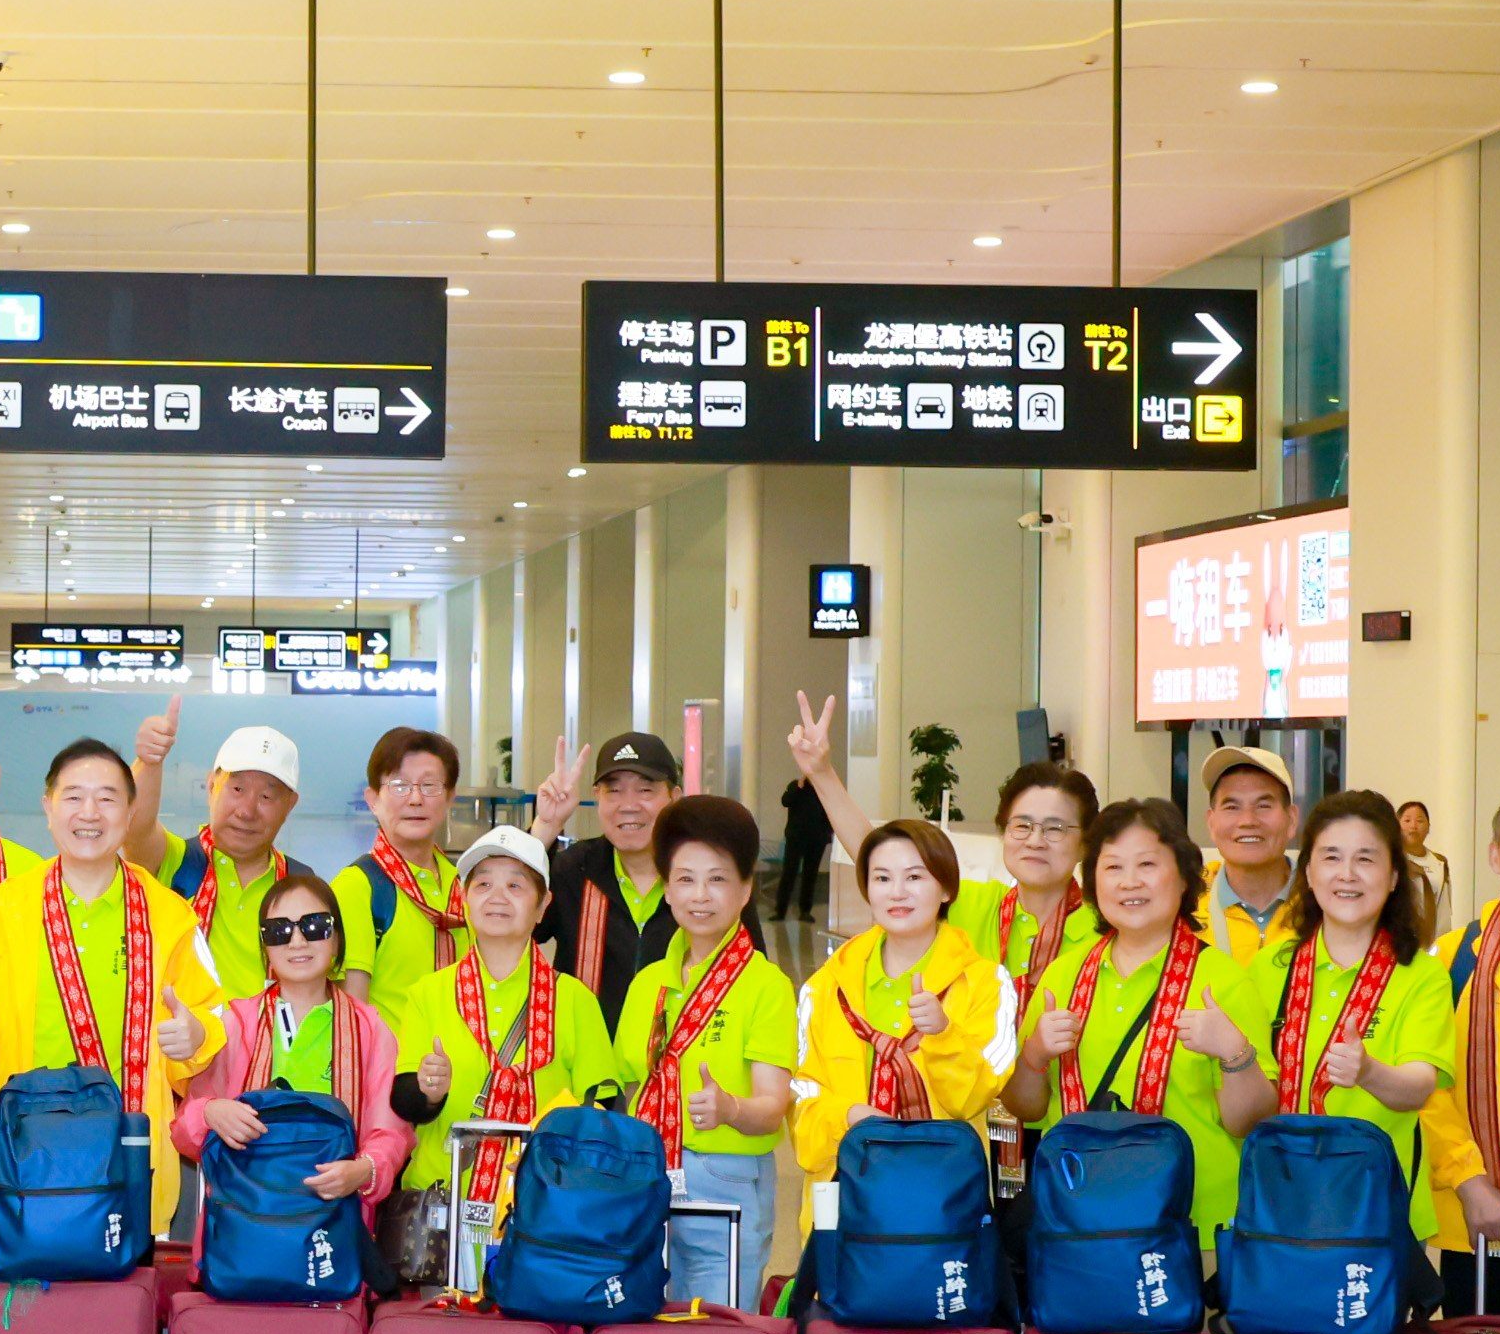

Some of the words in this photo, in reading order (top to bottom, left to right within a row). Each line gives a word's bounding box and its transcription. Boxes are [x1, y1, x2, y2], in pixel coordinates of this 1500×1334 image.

[619, 320, 694, 347] 停车场
[864, 322, 1013, 350] 龙洞堡高铁站
[641, 348, 693, 366] Parking
[767, 336, 808, 367] B1
[916, 351, 966, 369] Railway
[967, 352, 1012, 367] Station
[1084, 340, 1128, 371] T2
[49, 384, 149, 410] 机场巴士
[228, 386, 328, 414] 长途汽车
[618, 381, 693, 407] 摆渡车
[827, 383, 901, 410] 网约车
[961, 384, 1013, 411] 地铁
[72, 413, 118, 430] Airport
[121, 413, 148, 428] Bus
[626, 409, 663, 427] Ferry
[665, 410, 693, 424] Bus
[842, 412, 902, 429] E-hailing
[972, 413, 1013, 428] Metro
[1141, 395, 1191, 423] 出口
[282, 415, 328, 431] Coach
[1162, 424, 1191, 440] Exit
